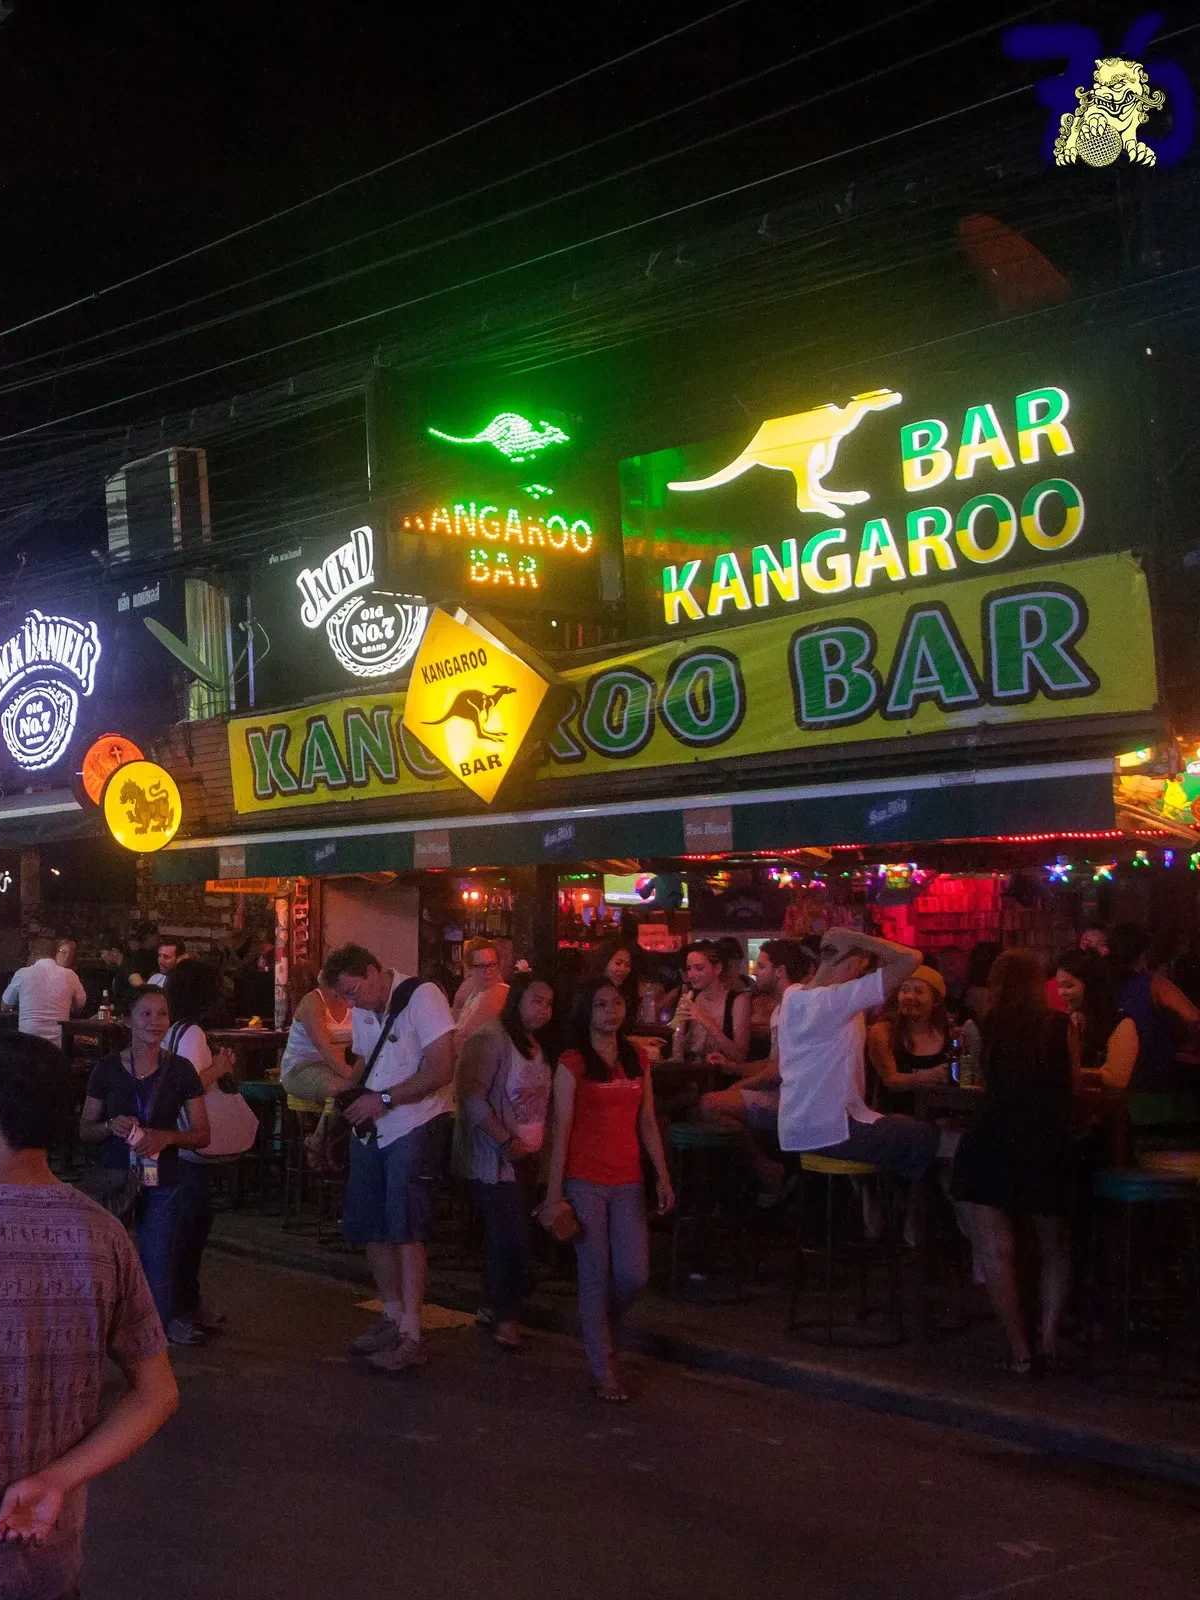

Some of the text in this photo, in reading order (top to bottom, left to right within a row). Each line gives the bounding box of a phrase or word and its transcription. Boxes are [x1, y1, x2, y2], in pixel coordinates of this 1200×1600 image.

[901, 386, 1074, 492] BAR
[403, 502, 593, 553] ANGAROO
[470, 549, 539, 588] BAR
[663, 478, 1084, 625] KANGAROO
[300, 549, 352, 622] JACK
[351, 616, 397, 645] No.7
[361, 606, 384, 621] Old
[22, 616, 94, 688] DANIEL'S
[362, 643, 388, 654] BRAND
[420, 648, 488, 684] KANGAROO
[794, 590, 1091, 724] BAR
[18, 712, 51, 738] No.7
[26, 700, 43, 714] Old
[459, 754, 504, 777] BAR
